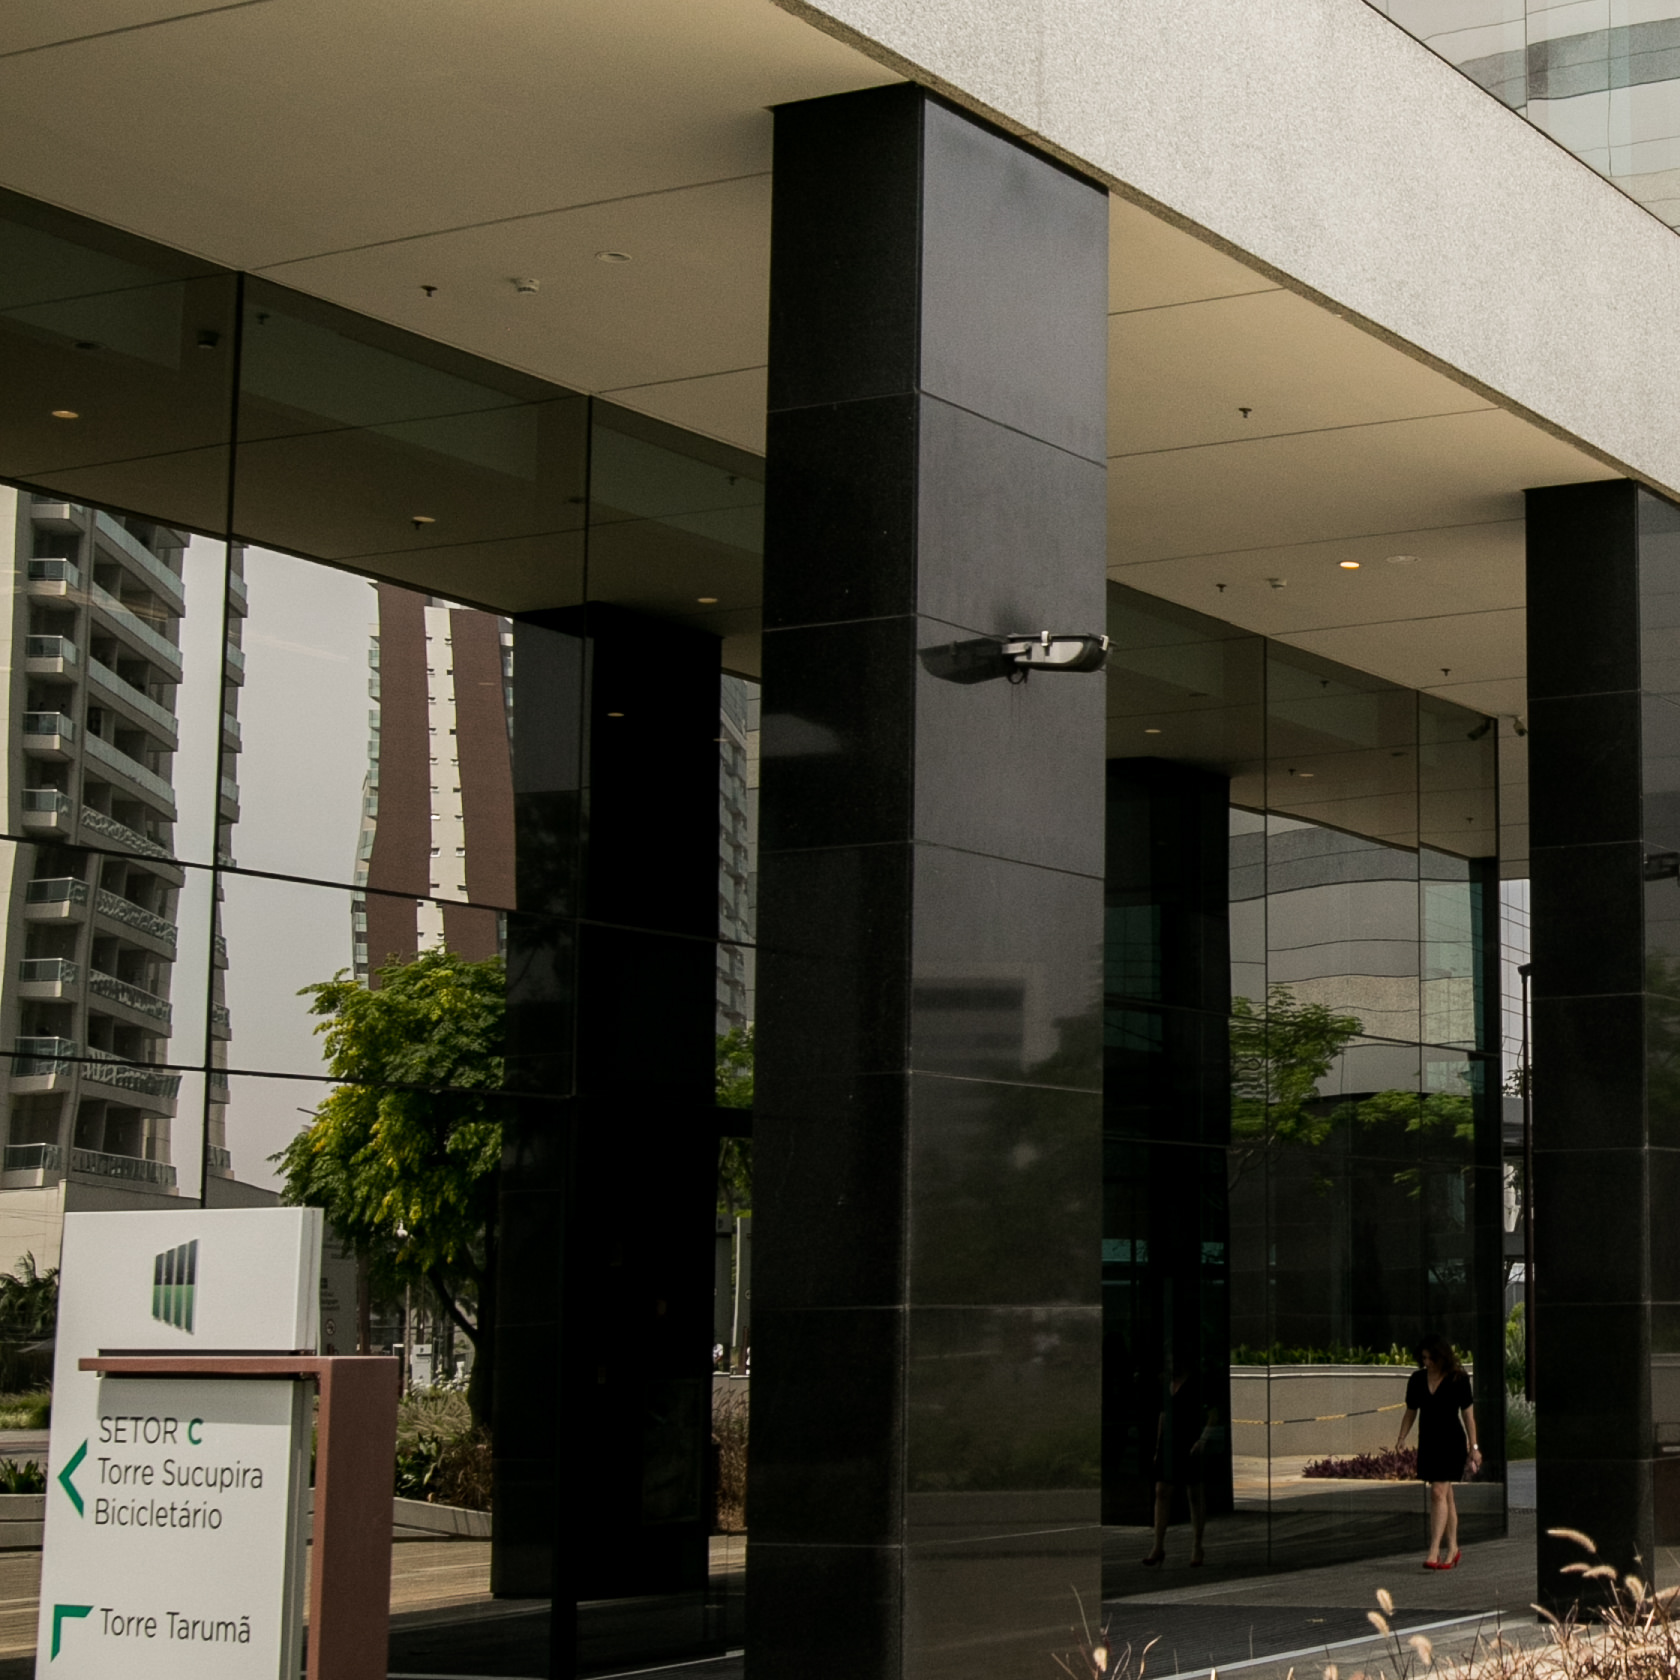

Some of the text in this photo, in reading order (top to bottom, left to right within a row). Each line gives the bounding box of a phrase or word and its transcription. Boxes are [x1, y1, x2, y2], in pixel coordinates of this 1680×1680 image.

[99, 1416, 204, 1445] SETOR C
[97, 1457, 263, 1493] Torre Sucupira
[95, 1498, 222, 1530] Bicicletário
[100, 1608, 251, 1644] Torre Tarumã
